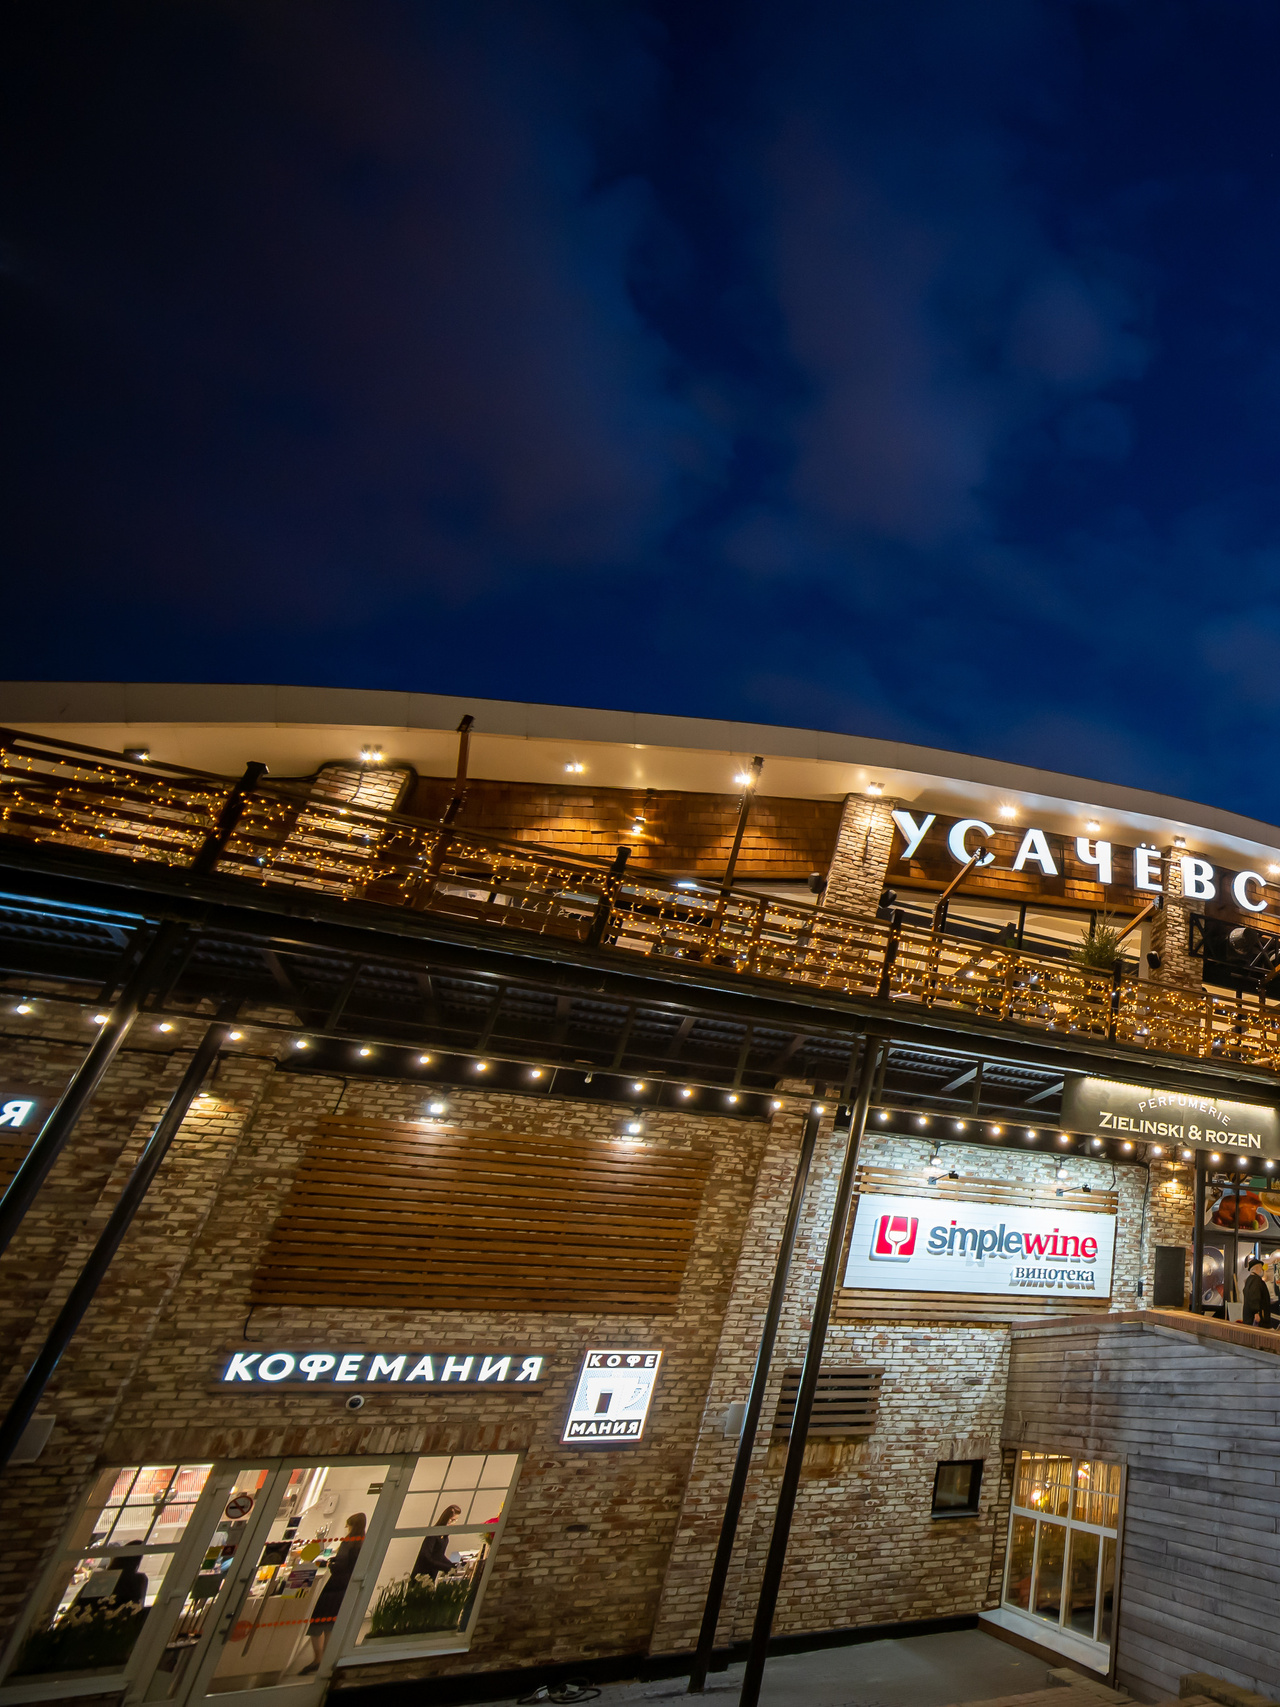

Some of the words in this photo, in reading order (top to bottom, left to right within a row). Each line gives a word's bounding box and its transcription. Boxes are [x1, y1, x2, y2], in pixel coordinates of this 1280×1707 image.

[1138, 1095, 1231, 1127] PERFUMERIE
[1099, 1111, 1185, 1139] ZIELINSKI
[1188, 1125, 1202, 1141] &
[1205, 1129, 1262, 1149] ROZEN
[927, 1219, 1098, 1260] simplewine
[1014, 1266, 1095, 1282] винотека
[223, 1353, 543, 1382] КОФЕМАНИЯ
[589, 1353, 656, 1368] КОФЕ
[570, 1420, 640, 1436] МАНИЯ
